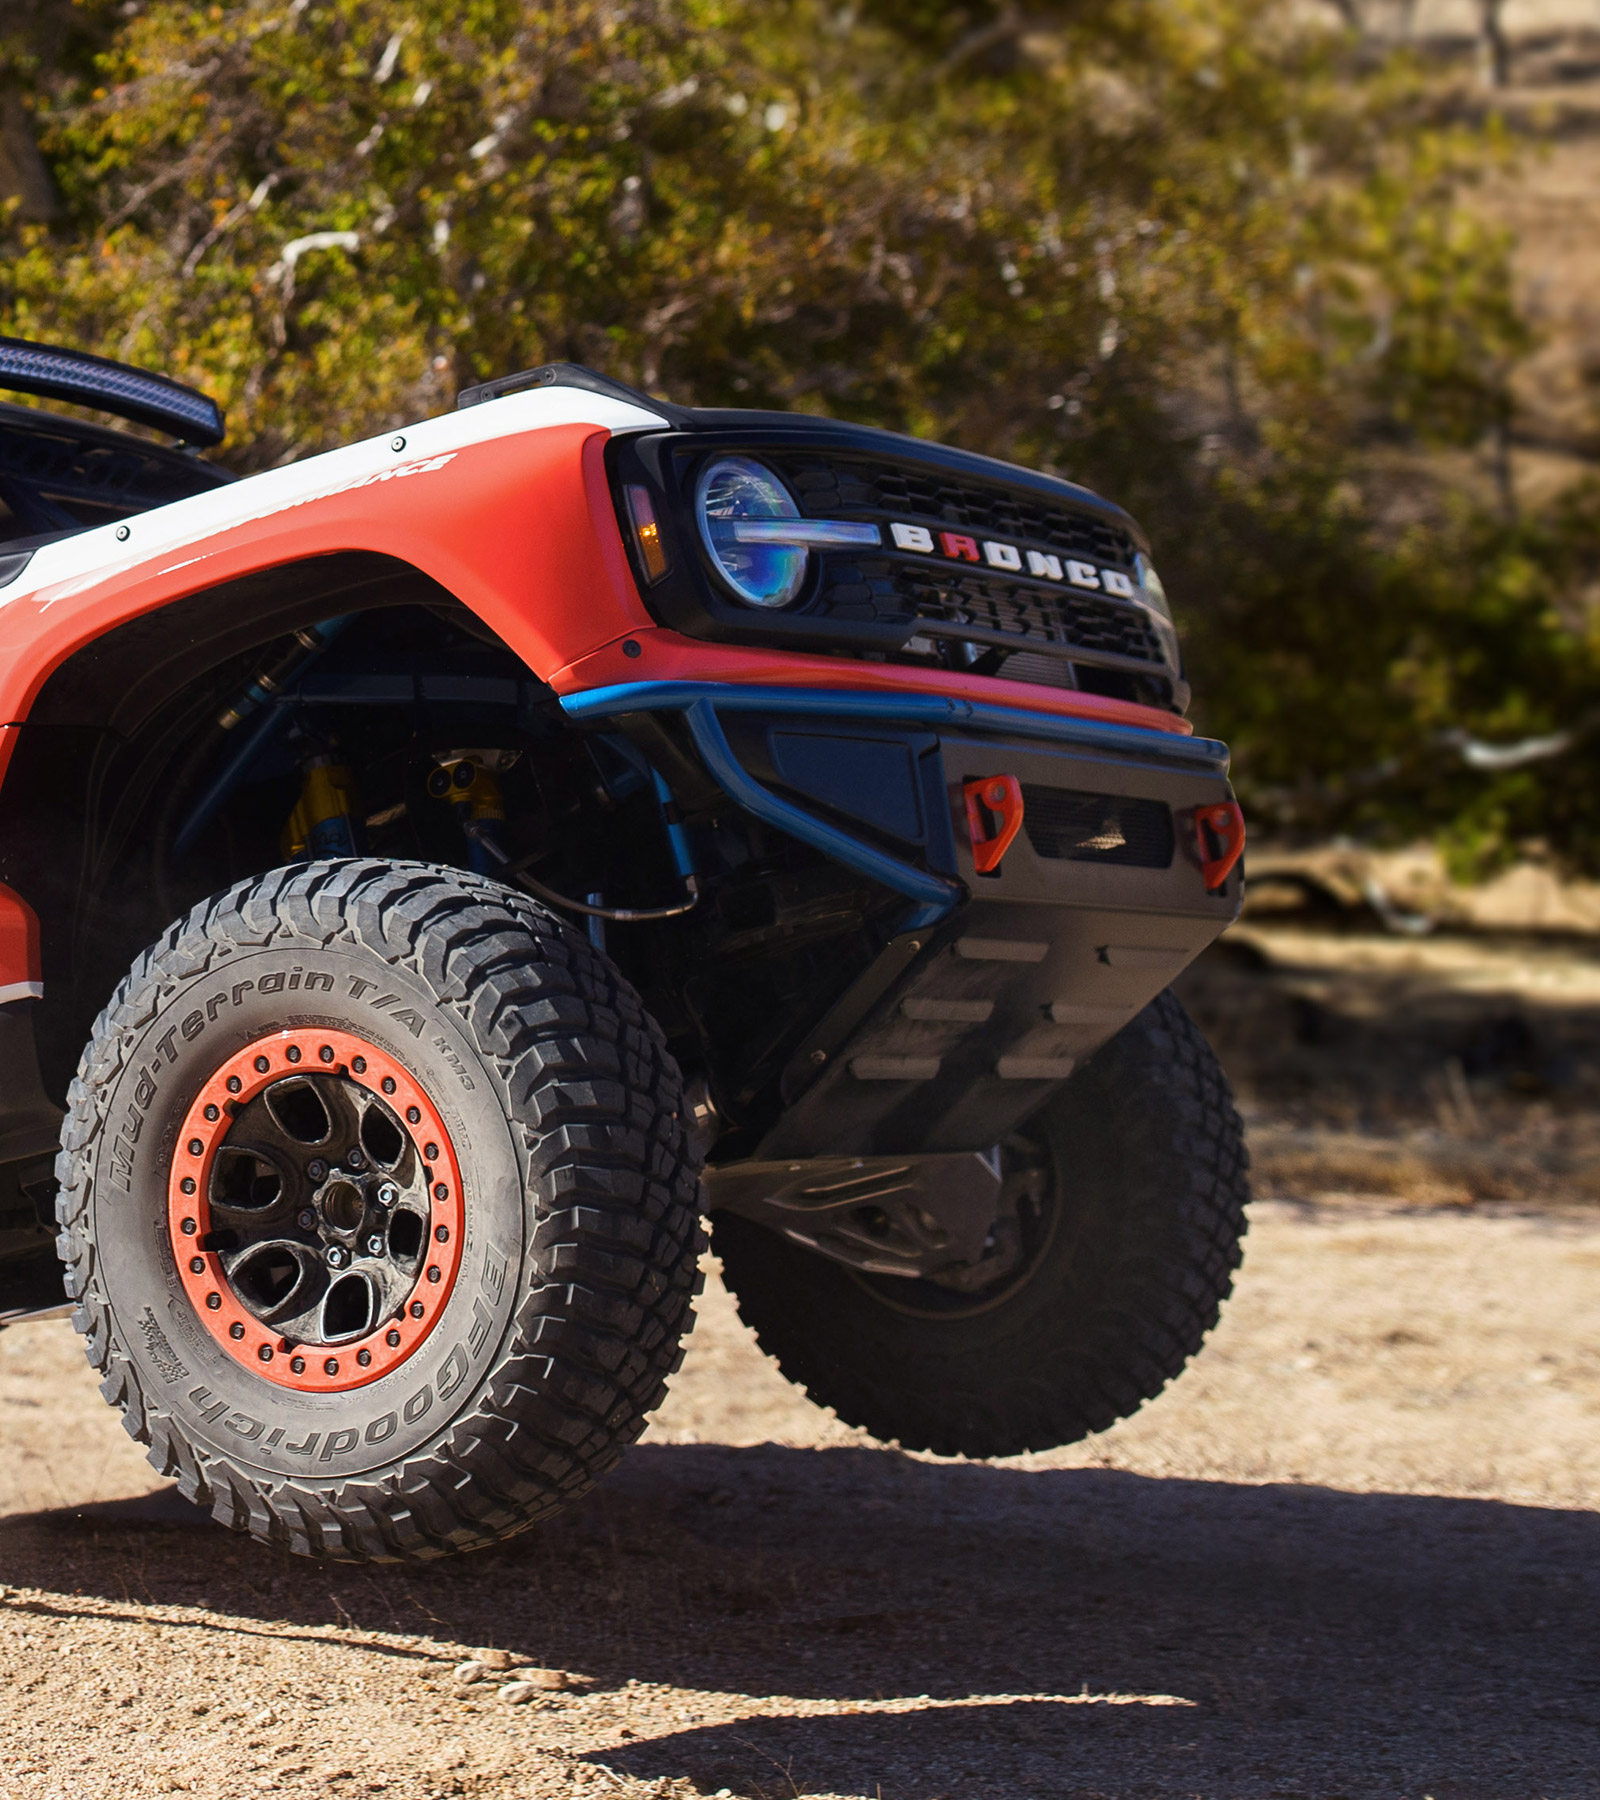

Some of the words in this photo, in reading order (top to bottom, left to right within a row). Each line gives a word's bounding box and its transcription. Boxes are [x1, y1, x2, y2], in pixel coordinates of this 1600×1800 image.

[890, 522, 1134, 598] BRONCO
[109, 966, 335, 1192] Mud-Terrain
[348, 974, 427, 1039] T/A
[432, 1036, 476, 1091] KM3
[188, 1241, 509, 1463] BFGoodrich
